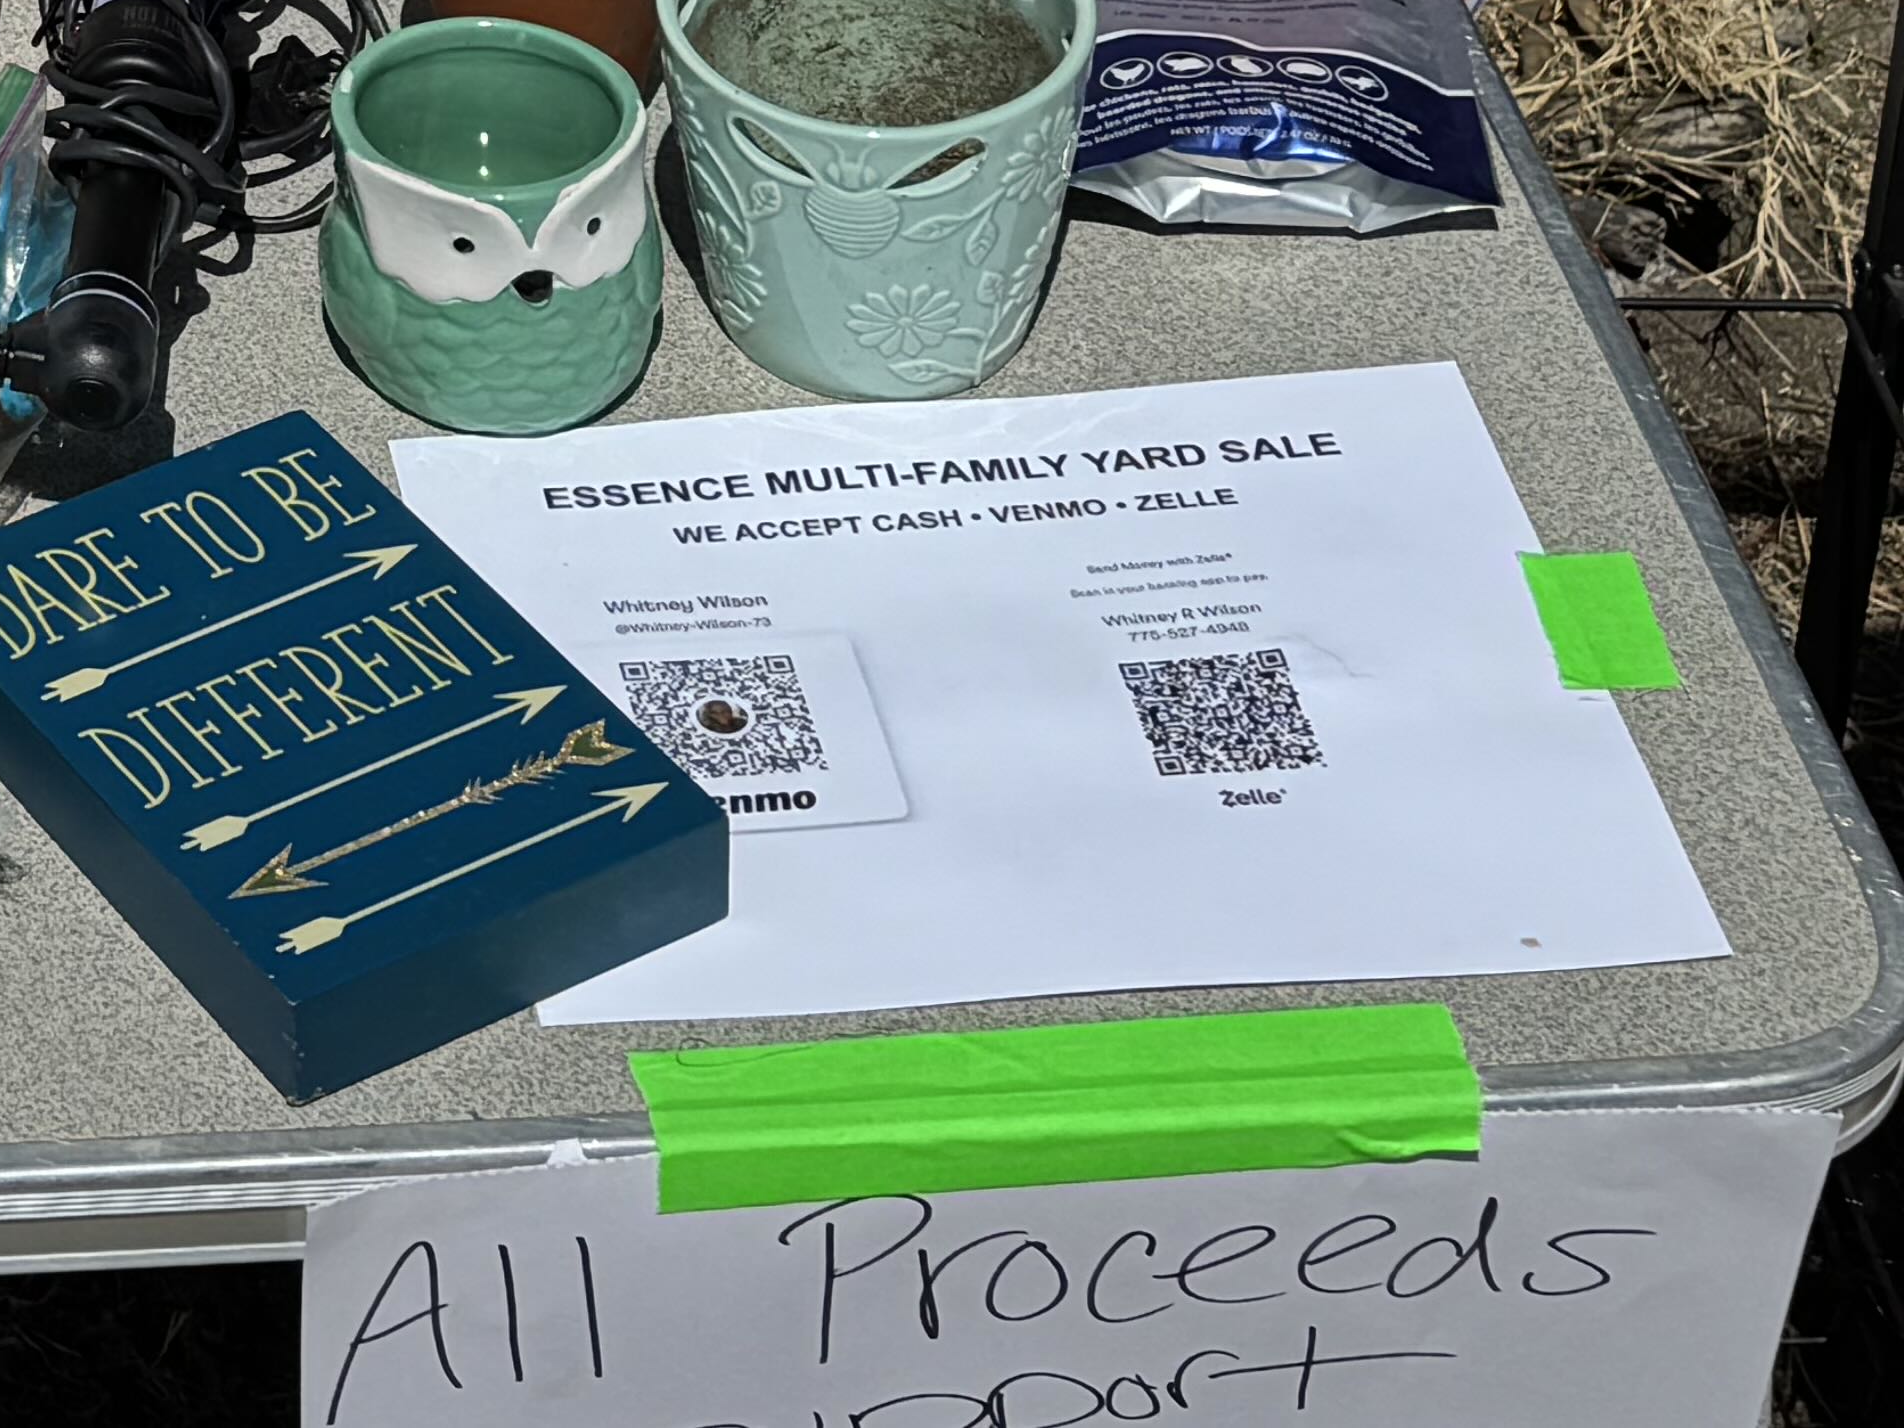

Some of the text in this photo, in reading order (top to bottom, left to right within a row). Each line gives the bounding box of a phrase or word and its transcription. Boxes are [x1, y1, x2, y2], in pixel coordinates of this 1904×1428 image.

[542, 430, 1343, 512] ESSENCE MULTI-FAMILY YARD SALE
[140, 490, 266, 580] TO
[241, 447, 377, 542] BE
[672, 487, 1240, 546] WE ACCEPT CASH VENMO ZELLE
[602, 593, 769, 615] Whitney Wilson
[1100, 601, 1262, 628] Whitney R Wilson
[78, 584, 515, 810] DIFFERENT
[713, 789, 817, 815] enmo
[326, 1191, 1659, 1425] All Proceeds
